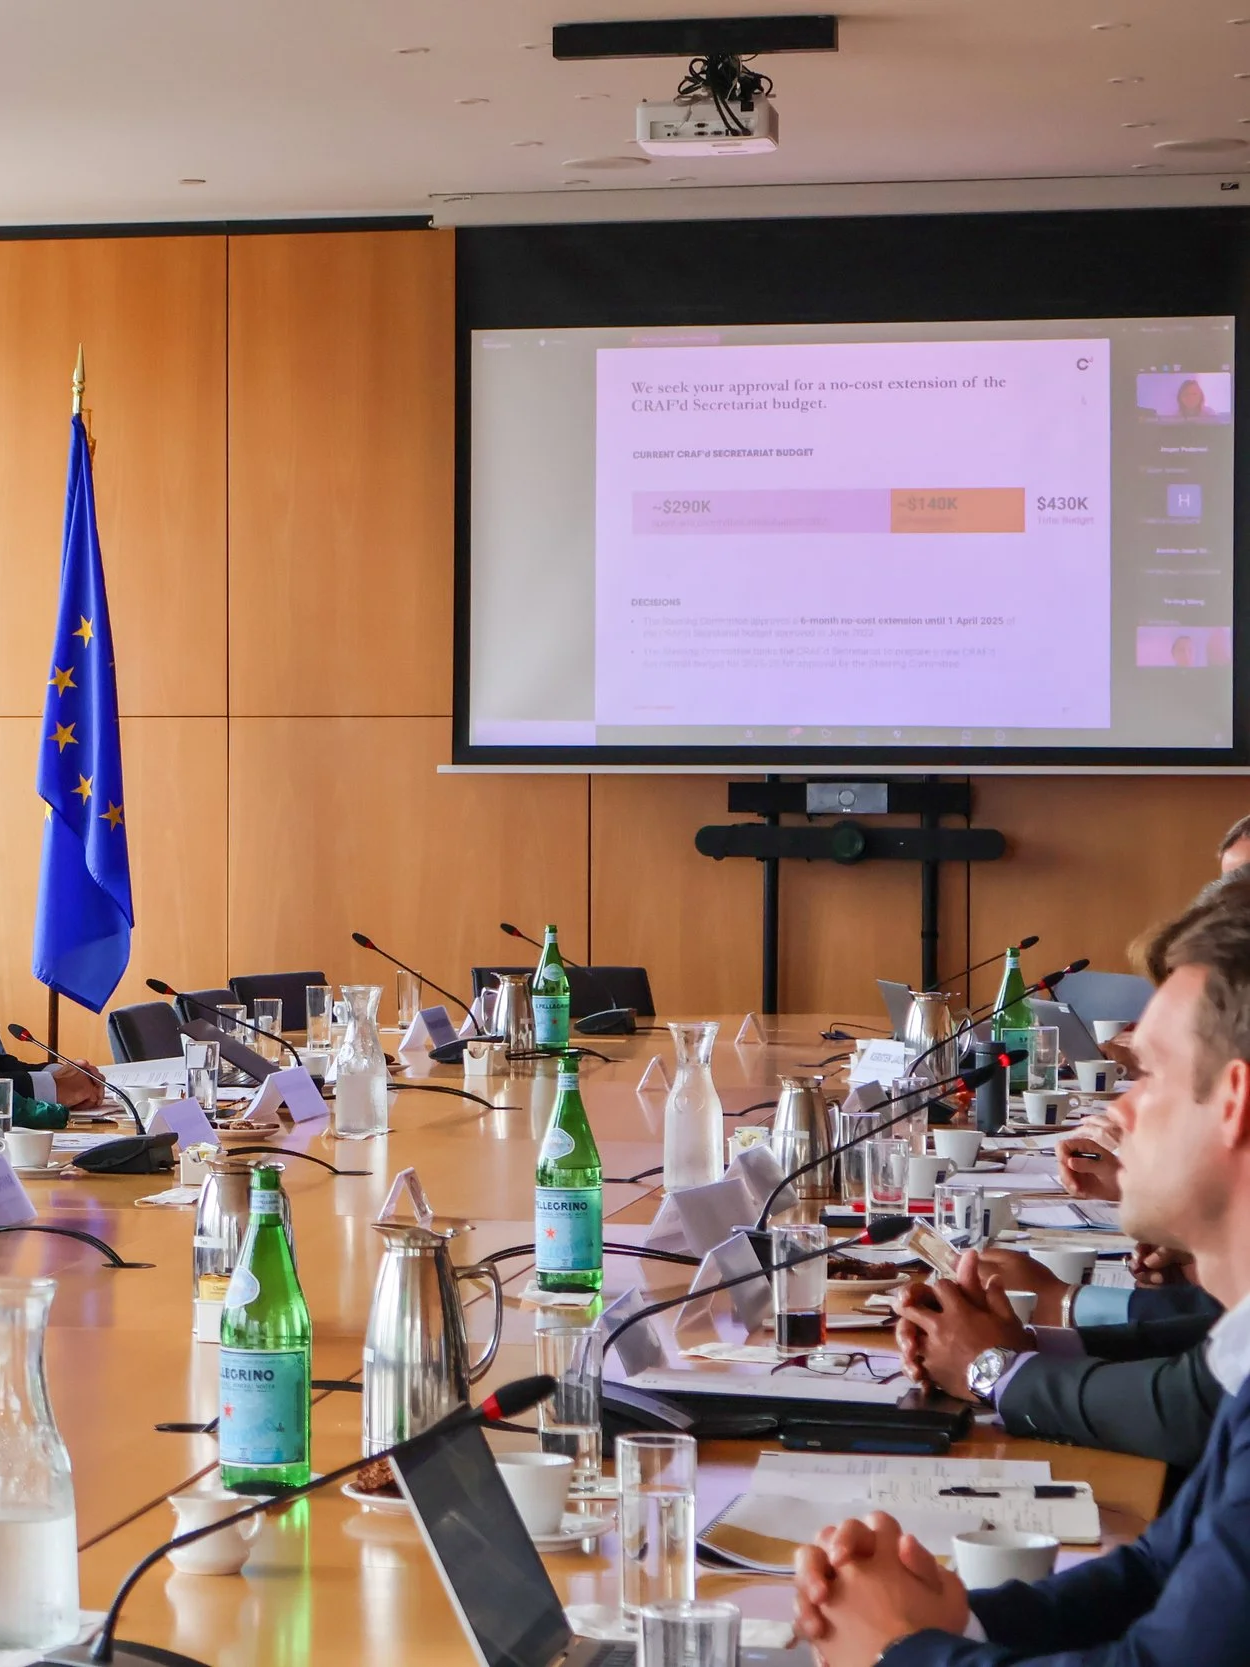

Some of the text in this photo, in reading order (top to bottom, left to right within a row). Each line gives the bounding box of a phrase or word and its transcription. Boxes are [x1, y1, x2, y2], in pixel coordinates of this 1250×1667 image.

[631, 376, 1006, 397] We seek your approval for a no-cost extension of the
[693, 398, 768, 411] Secretariat
[773, 397, 827, 413] budget.
[633, 451, 675, 459] CURRENT
[713, 449, 773, 458] SECRETARIAT
[776, 448, 814, 457] BUDGET
[1037, 496, 1089, 511] $430K
[1178, 493, 1190, 507] H
[631, 598, 681, 607] DECISIONS
[800, 617, 839, 625] 6-month
[841, 617, 876, 625] no-cost
[878, 617, 922, 625] extension
[925, 616, 946, 625] until
[956, 616, 978, 628] April
[980, 617, 1004, 625] 2025
[537, 1201, 588, 1212] LLEGRINO
